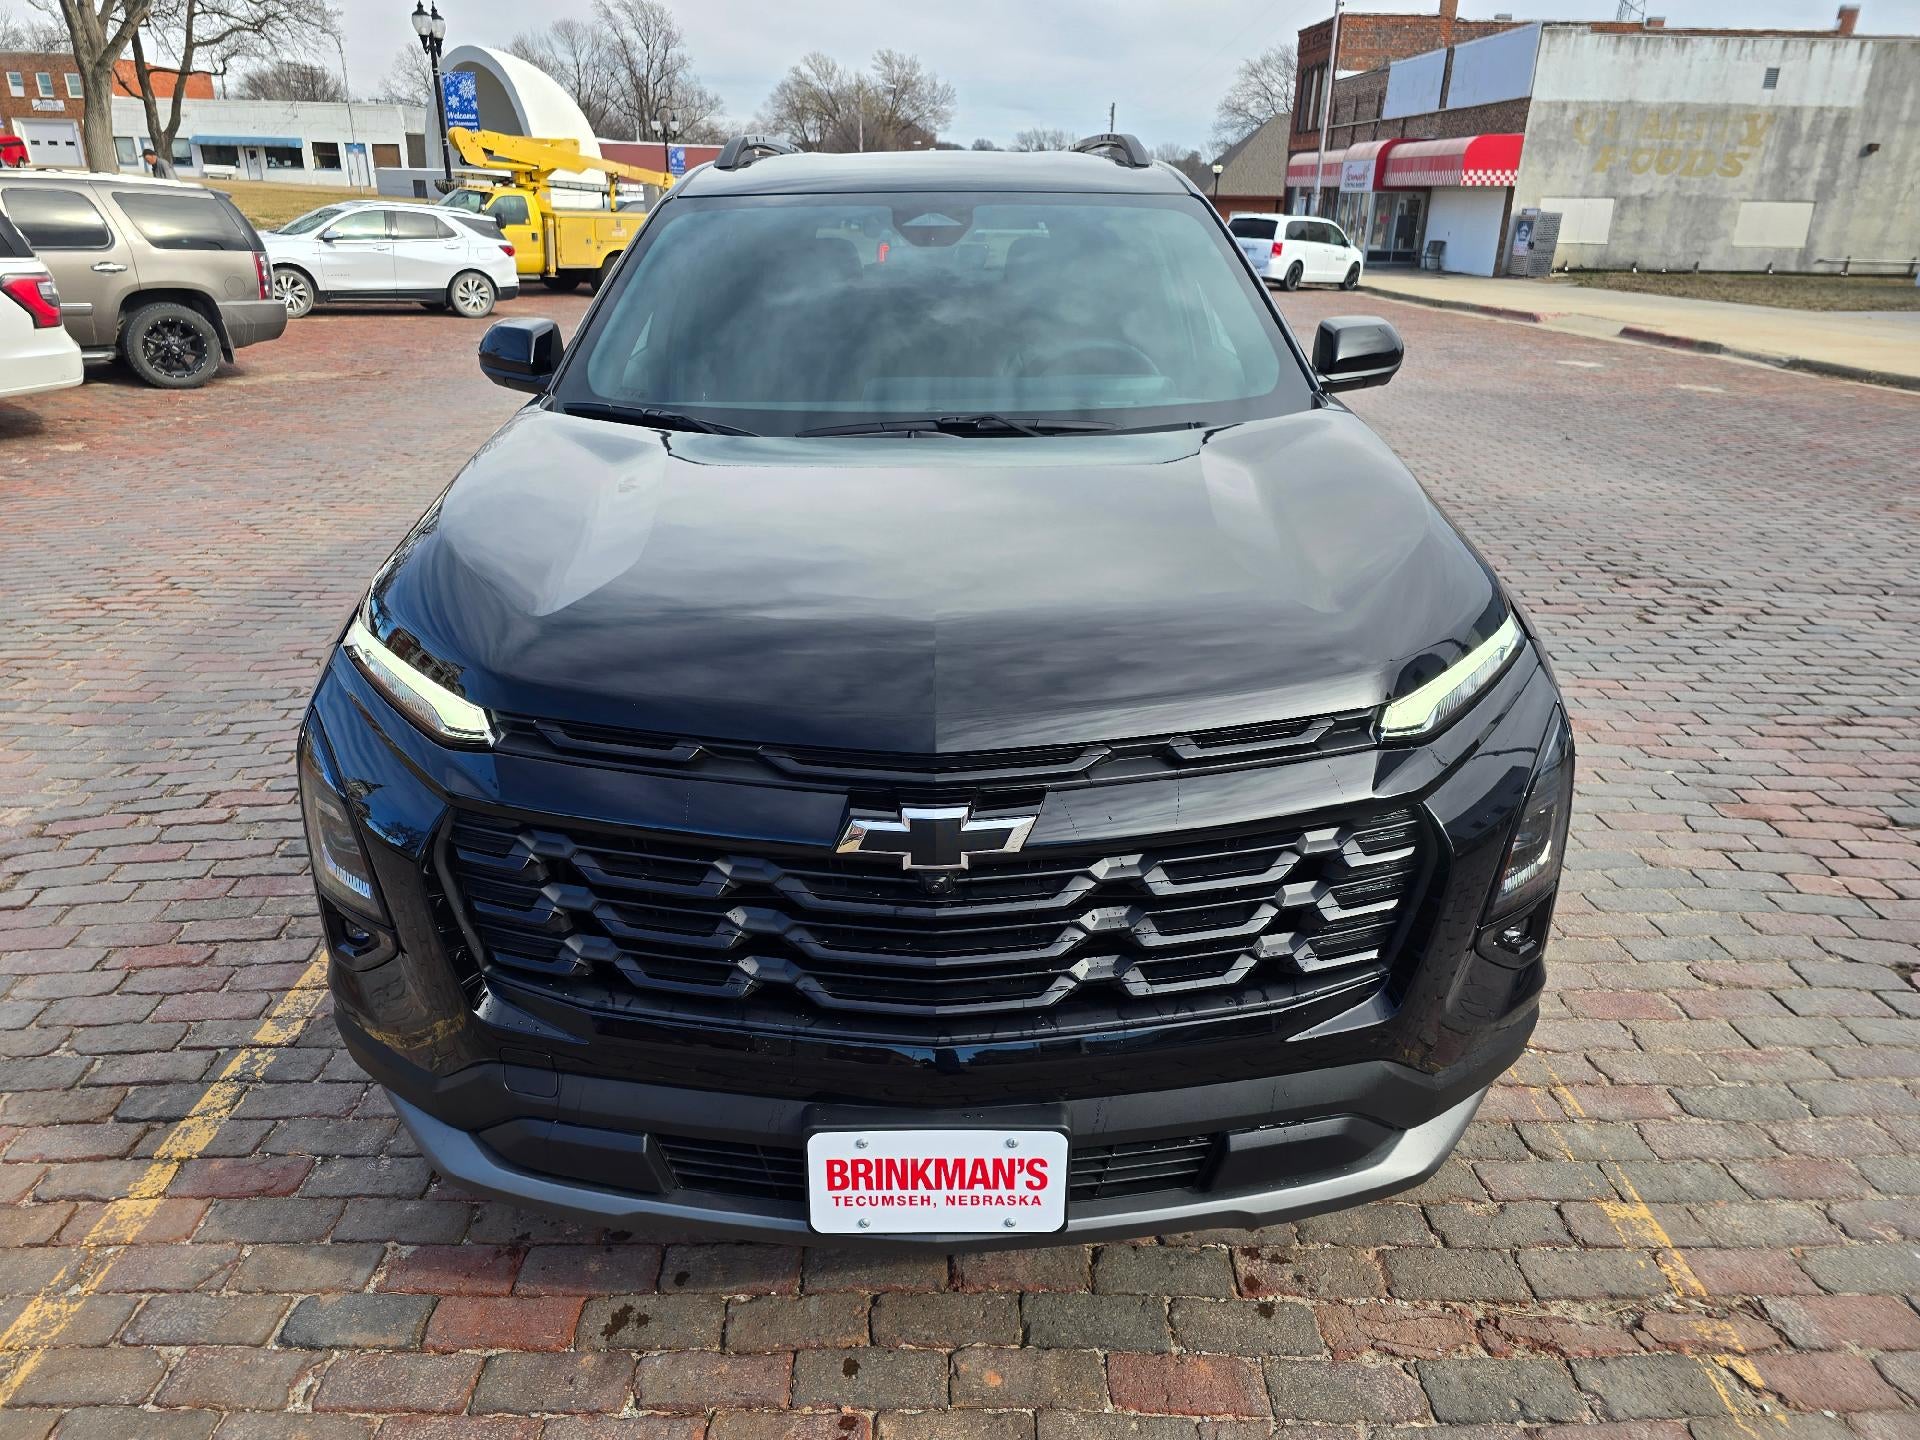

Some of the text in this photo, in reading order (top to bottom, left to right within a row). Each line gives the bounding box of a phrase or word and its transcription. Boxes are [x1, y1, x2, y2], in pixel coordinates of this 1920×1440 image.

[1592, 145, 1750, 178] FOODS
[826, 1158, 1048, 1191] BRINKMAN'S
[832, 1194, 1042, 1208] TECUMSEH, NEBRASKA
